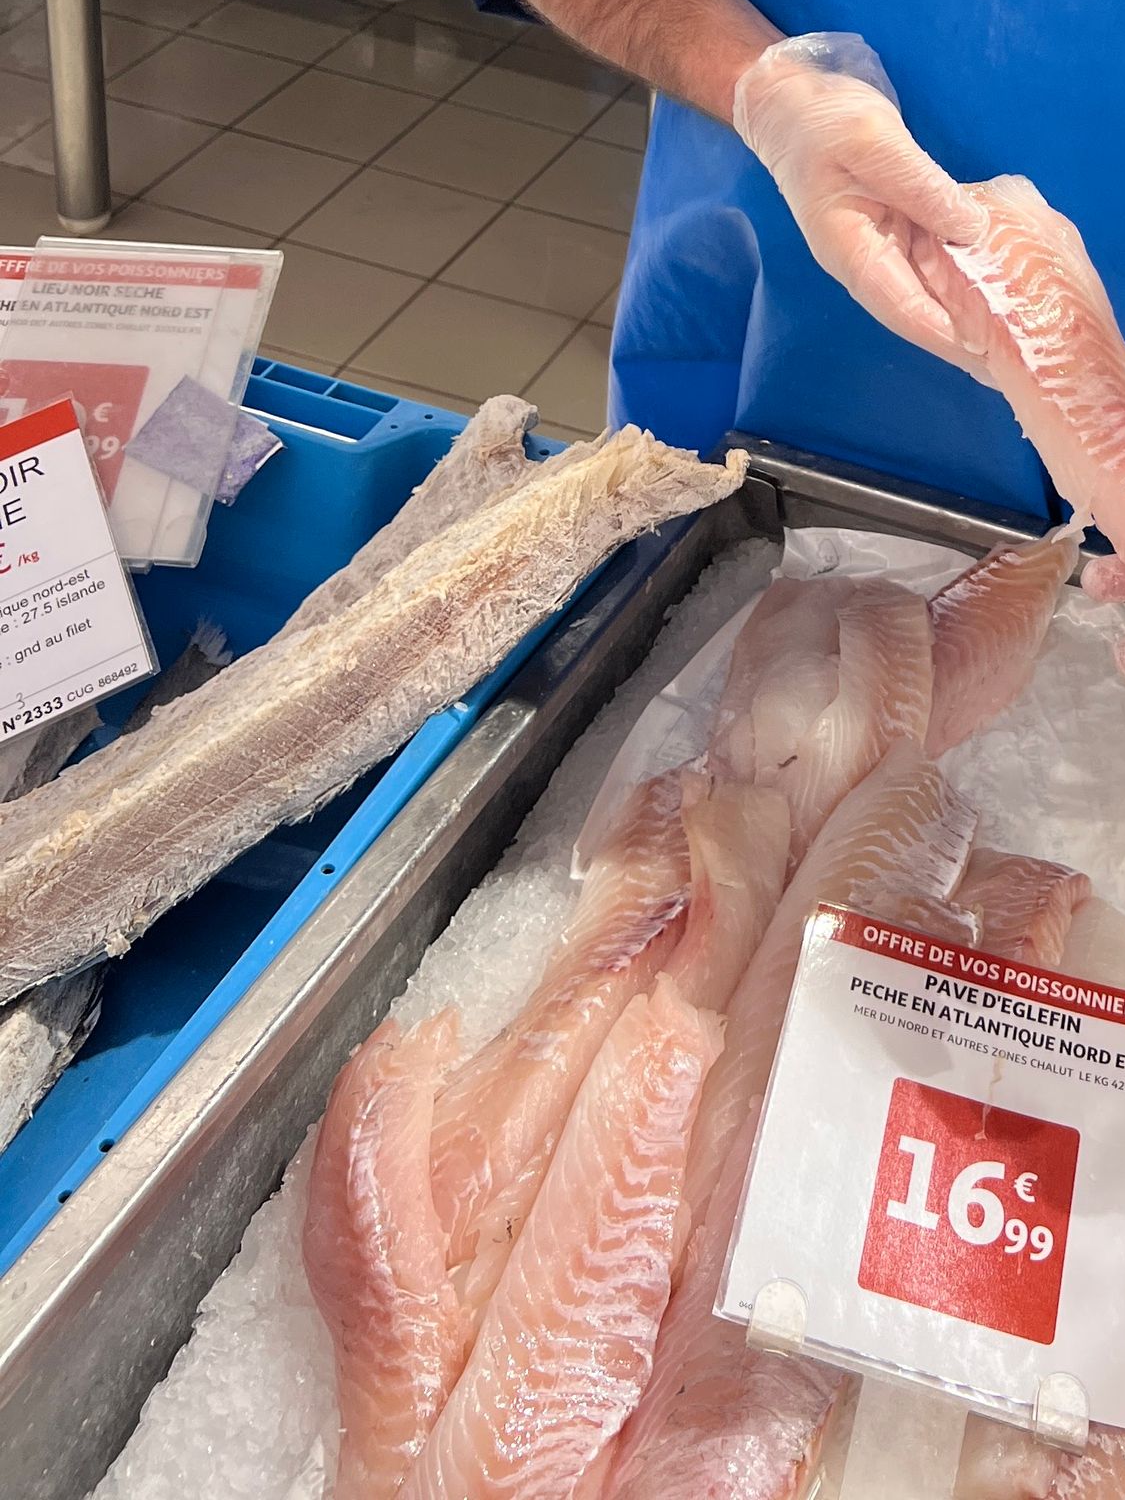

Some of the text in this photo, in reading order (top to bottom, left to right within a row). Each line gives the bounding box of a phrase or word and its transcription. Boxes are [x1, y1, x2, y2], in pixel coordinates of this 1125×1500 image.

[32, 282, 67, 295] LIEU
[71, 284, 110, 297] NOIR
[48, 260, 226, 281] DE VOS POISSONNIERS
[42, 302, 136, 317] ATLANTIQUE
[184, 308, 213, 320] EST
[17, 551, 40, 567] /kg
[32, 569, 91, 603] nord-est
[56, 579, 106, 609] islande
[14, 618, 92, 664] gnd au filet
[2, 662, 139, 734] N°2333 CUG 868492
[863, 925, 926, 959] OFFRE
[928, 945, 955, 968] DE
[959, 953, 1001, 981] VOS
[850, 976, 909, 1007] PECHE
[911, 996, 936, 1016] EN
[938, 1003, 1055, 1052] ATLANTIQUE
[1059, 1039, 1112, 1066] NORD
[924, 974, 1082, 1034] PAVE D'EGLEFIN
[853, 1004, 878, 1019] MER
[879, 1011, 896, 1025] DU
[897, 1016, 929, 1036] NORD
[931, 1027, 946, 1041] ET
[946, 1033, 990, 1055] AUTRES
[991, 1046, 1028, 1066] ZONES
[1030, 1057, 1075, 1079] CHALUT
[1078, 1069, 1092, 1082] LE
[1093, 1074, 1110, 1087] KG
[885, 1134, 1054, 1262] 16 € 99
